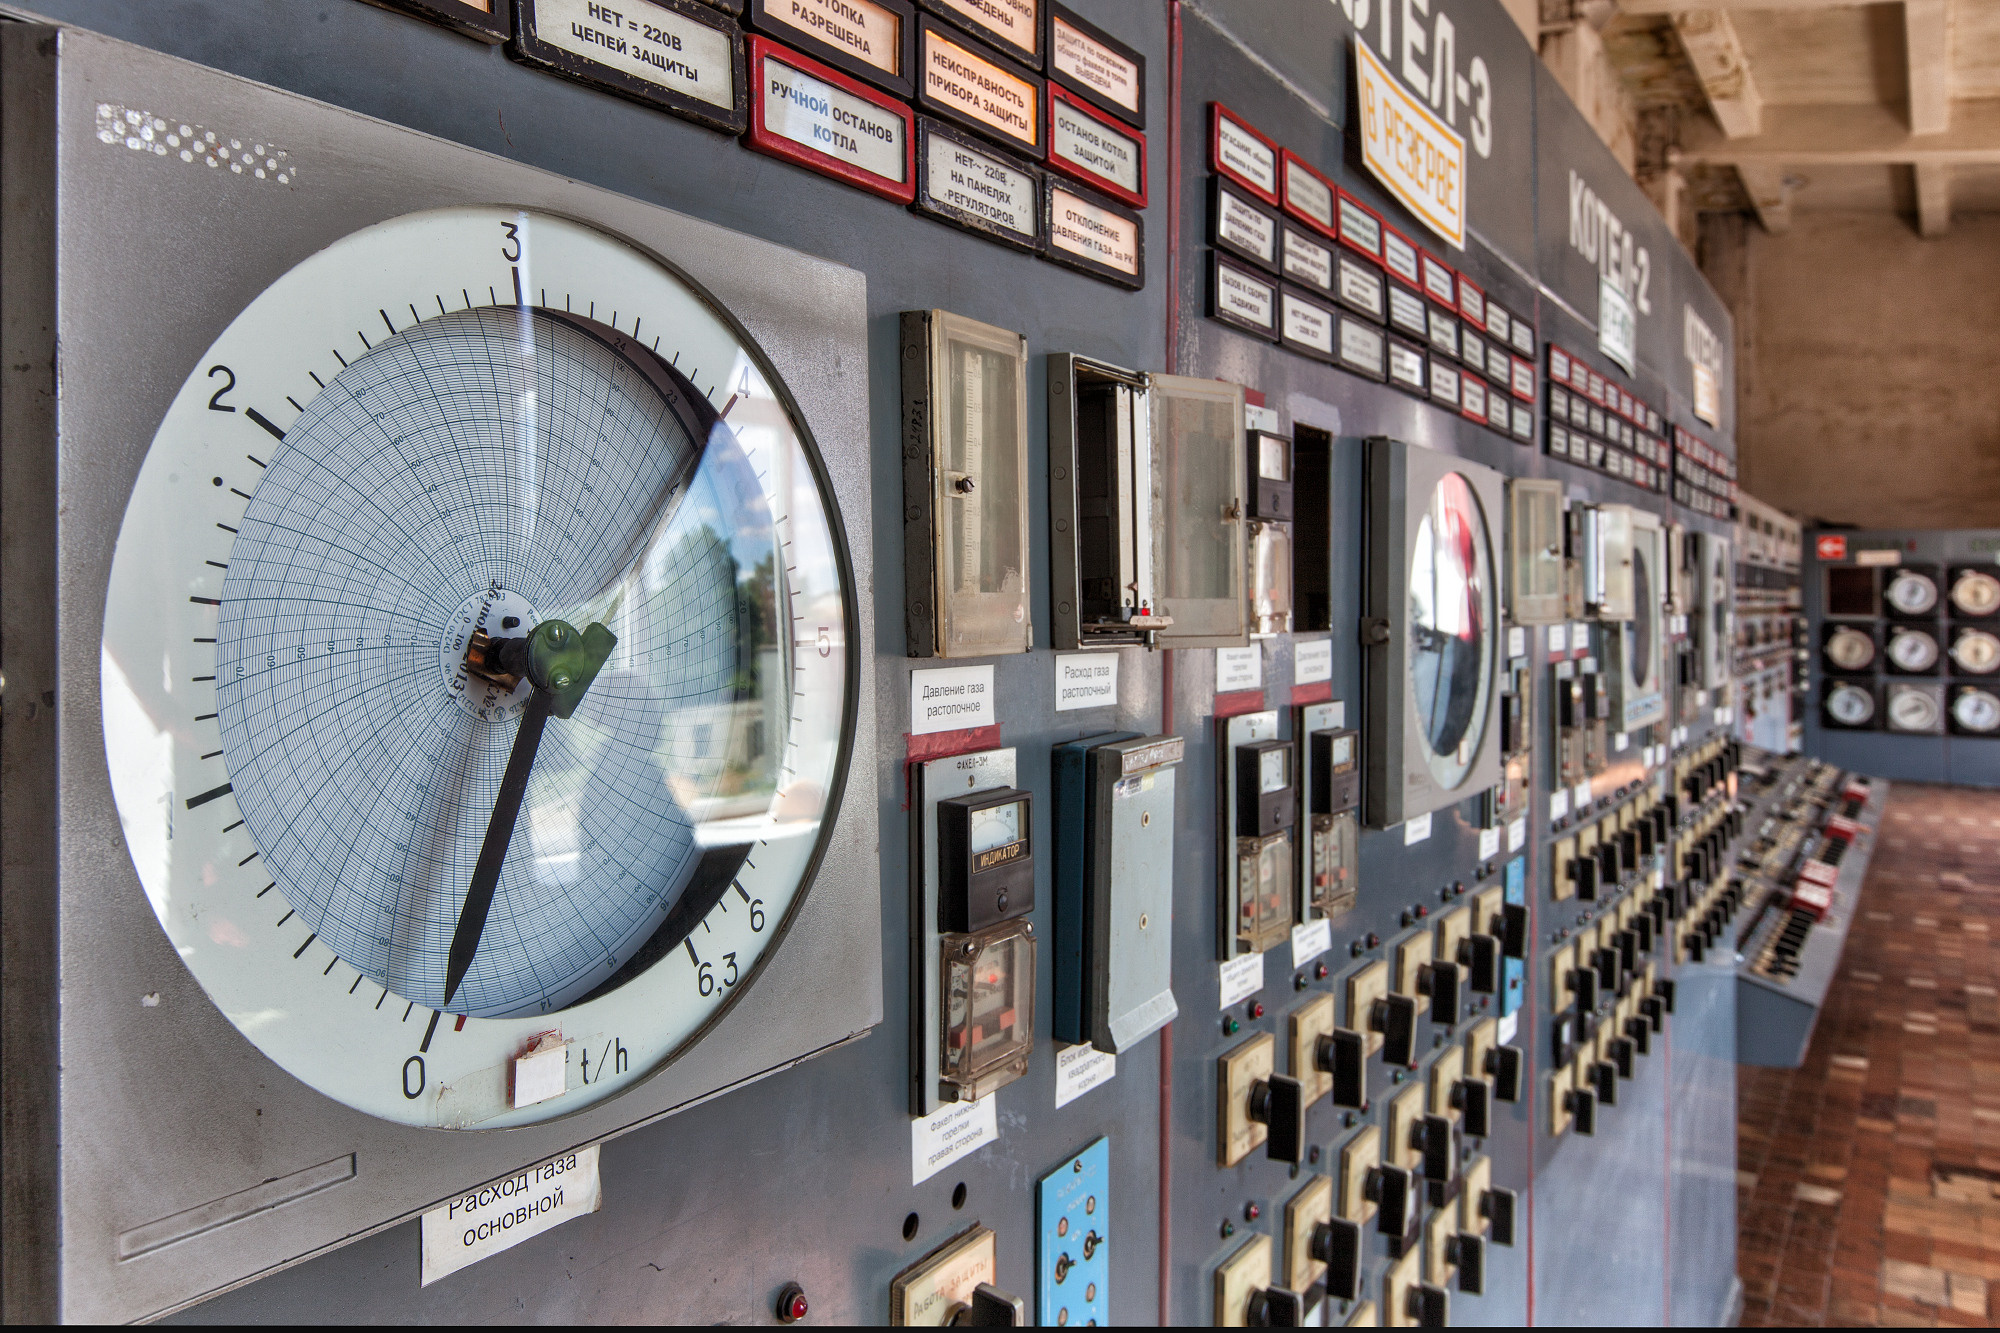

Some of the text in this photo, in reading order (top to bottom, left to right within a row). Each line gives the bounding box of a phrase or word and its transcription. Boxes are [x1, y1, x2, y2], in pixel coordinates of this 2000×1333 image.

[588, 1, 624, 28] НЕТ
[643, 24, 682, 51] 220В
[791, 1, 872, 55] РАЗРЕШЕНА
[1057, 28, 1085, 52] ЗАЩИТА
[571, 22, 699, 82] ЦЕПЕЙ ЗАЩИТЫ
[932, 51, 1025, 109] НЕИСПРАВНОСТЬ
[771, 80, 893, 143] РУЧНОЙ ОСТАНОВ
[928, 71, 1028, 132] ПРИБОРА ЗАЩИТЫ
[813, 123, 858, 154] КОТЛА
[1058, 117, 1128, 162] ОСТАНОВ КОТЛА
[1365, 76, 1378, 142] В
[1383, 97, 1458, 216] РЕЗЕРВЕ
[955, 152, 974, 169] НЕТ
[984, 165, 1006, 183] 220В
[1074, 144, 1116, 174] ЗАЩИТОЙ
[951, 170, 1011, 205] НА ПАНЕЛЯХ
[947, 189, 1015, 225] РЕГУЛЯТОРОВ
[501, 221, 522, 262] 3
[1051, 222, 1093, 248] ДАВЛЕНИЯ
[1094, 241, 1113, 257] ГАЗА
[1066, 209, 1120, 242] ОТКЛОНЕНИЕ
[207, 365, 236, 413] 2
[737, 365, 750, 399] 4
[817, 626, 831, 658] 5
[1064, 665, 1110, 681] Расход газа
[922, 681, 985, 701] Давление газа
[1062, 682, 1112, 702] растопочный
[927, 701, 981, 719] растопочное
[980, 844, 1020, 867] ИНДИКАТОР
[750, 899, 765, 932] 6
[698, 952, 739, 997] 6,3
[403, 1056, 426, 1099] 0
[580, 1037, 629, 1085] t/h
[1060, 1053, 1076, 1067] Блок
[930, 1114, 953, 1132] Факел
[942, 1120, 970, 1143] горелки
[927, 1127, 983, 1166] правая сторона
[449, 1154, 577, 1220] Расход газа
[463, 1186, 564, 1247] основной
[913, 1287, 945, 1320] РАБОТА
[950, 1258, 987, 1291] ЗАЩИТЫ
